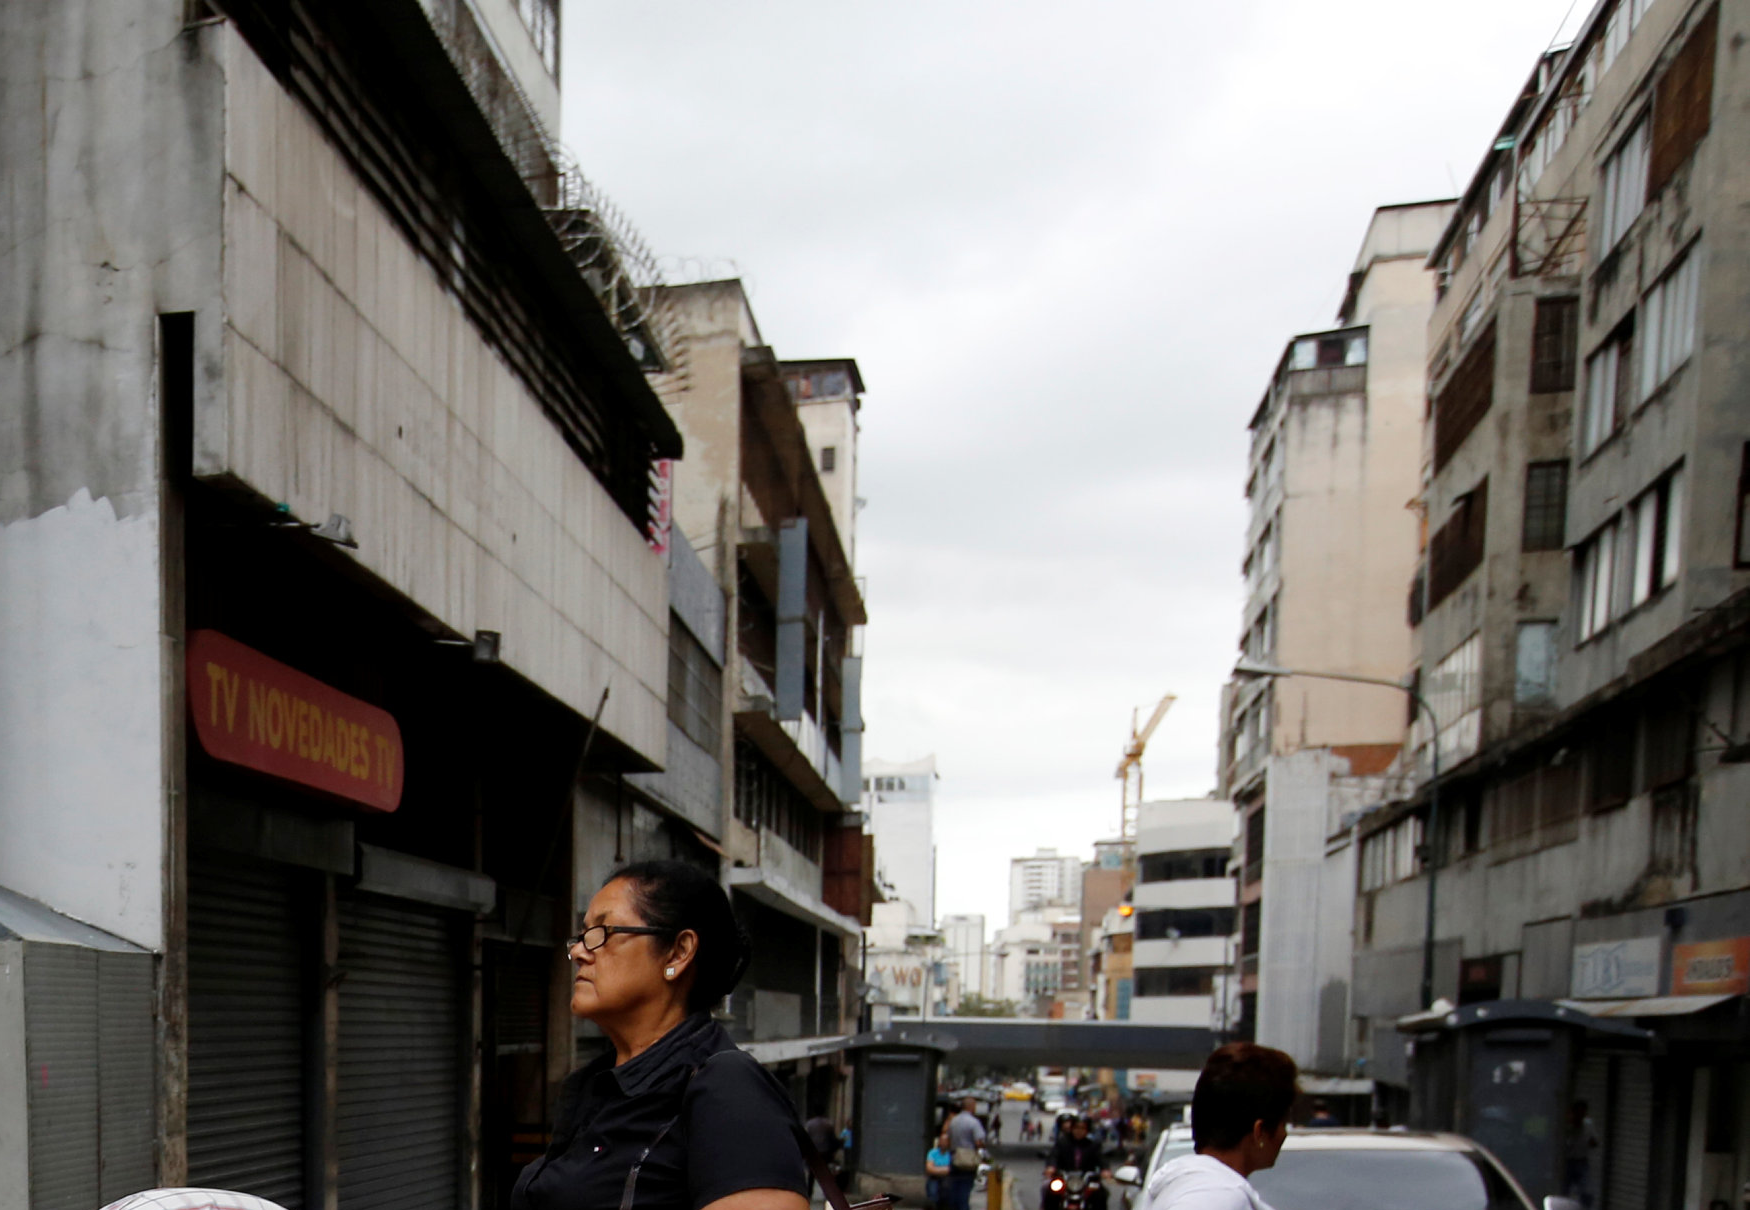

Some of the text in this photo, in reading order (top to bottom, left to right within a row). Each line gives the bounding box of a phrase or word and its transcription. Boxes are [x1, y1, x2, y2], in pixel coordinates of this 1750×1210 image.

[206, 661, 398, 791] TV NOVEDADES TV
